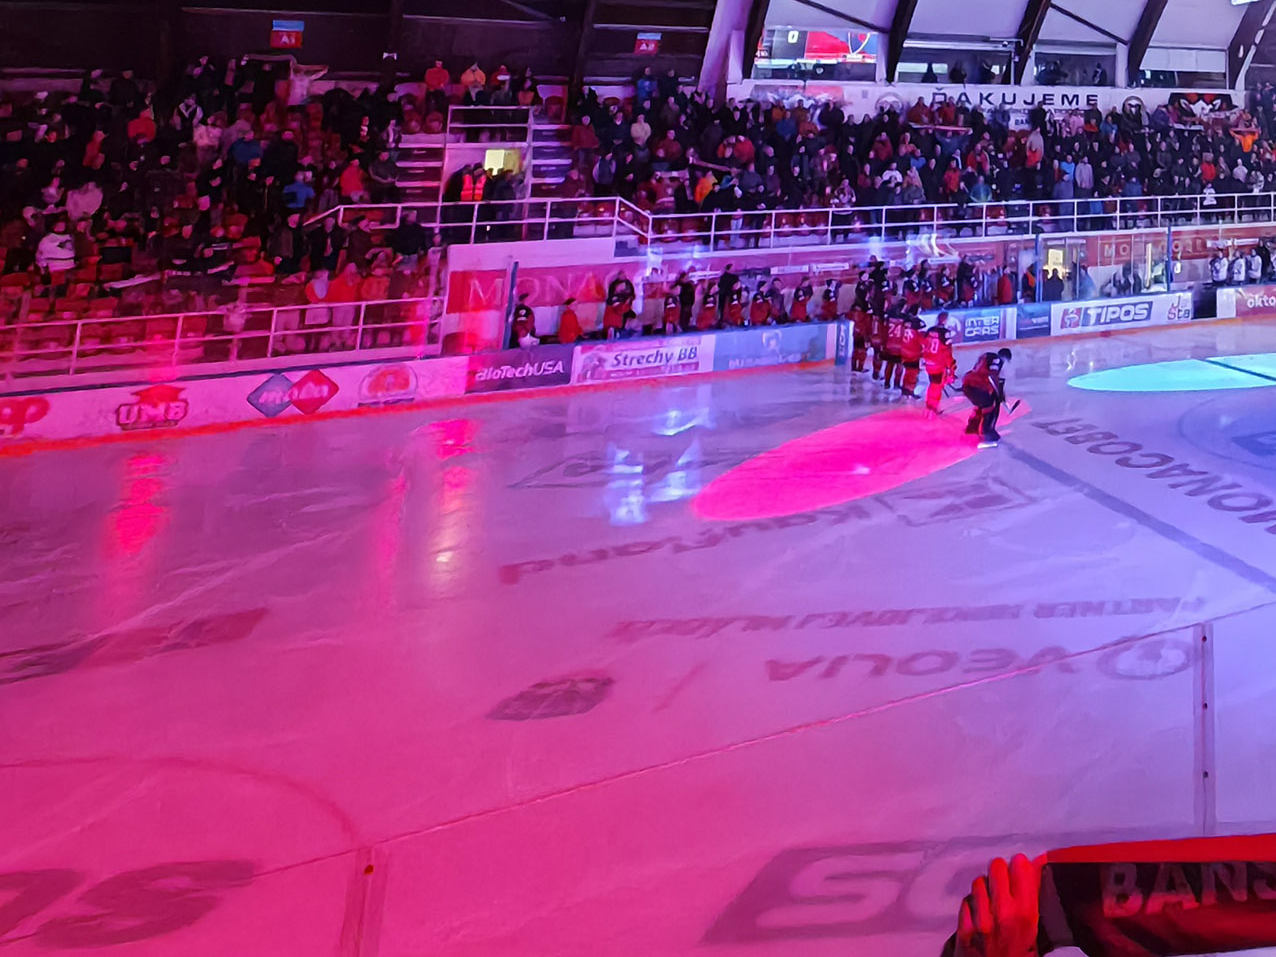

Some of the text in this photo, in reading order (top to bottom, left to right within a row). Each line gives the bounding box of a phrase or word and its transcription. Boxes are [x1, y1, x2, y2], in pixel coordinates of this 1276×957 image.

[1087, 303, 1150, 326] TIPOS
[611, 346, 698, 368] Strechy BB
[766, 645, 1079, 682] VEOLIA
